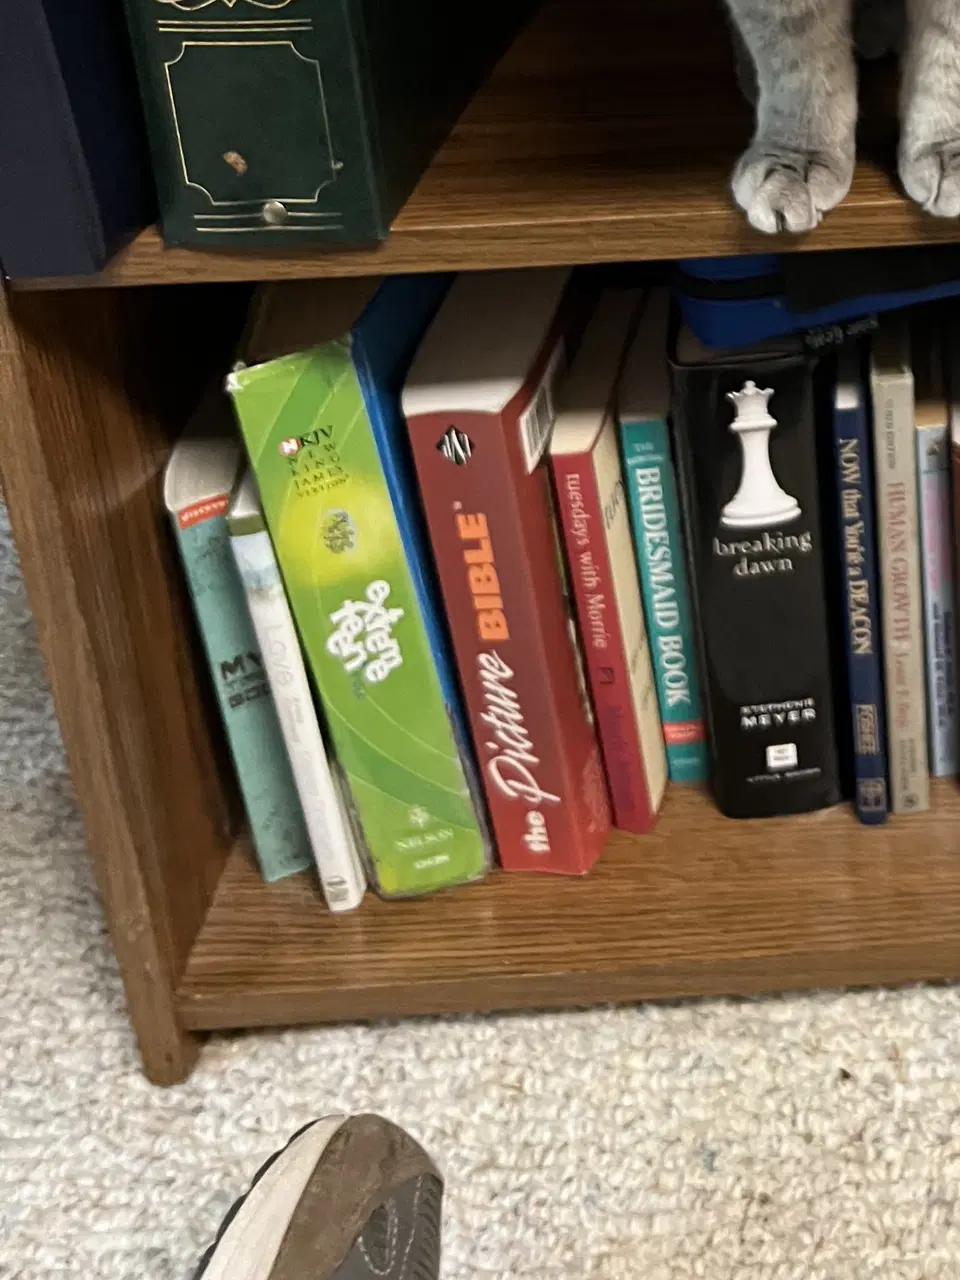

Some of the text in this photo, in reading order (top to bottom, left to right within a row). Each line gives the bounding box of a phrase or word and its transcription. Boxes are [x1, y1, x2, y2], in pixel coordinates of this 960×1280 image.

[839, 438, 861, 484] NOW
[841, 489, 862, 520] that
[712, 531, 813, 556] breaking
[577, 551, 598, 587] with
[733, 556, 794, 577] dawn
[635, 466, 680, 629] BRIDESMAID
[658, 635, 692, 707] BOOK
[584, 592, 609, 650] Morrie
[456, 512, 561, 853] the Picture BIBLE
[740, 708, 817, 730] MEYER
